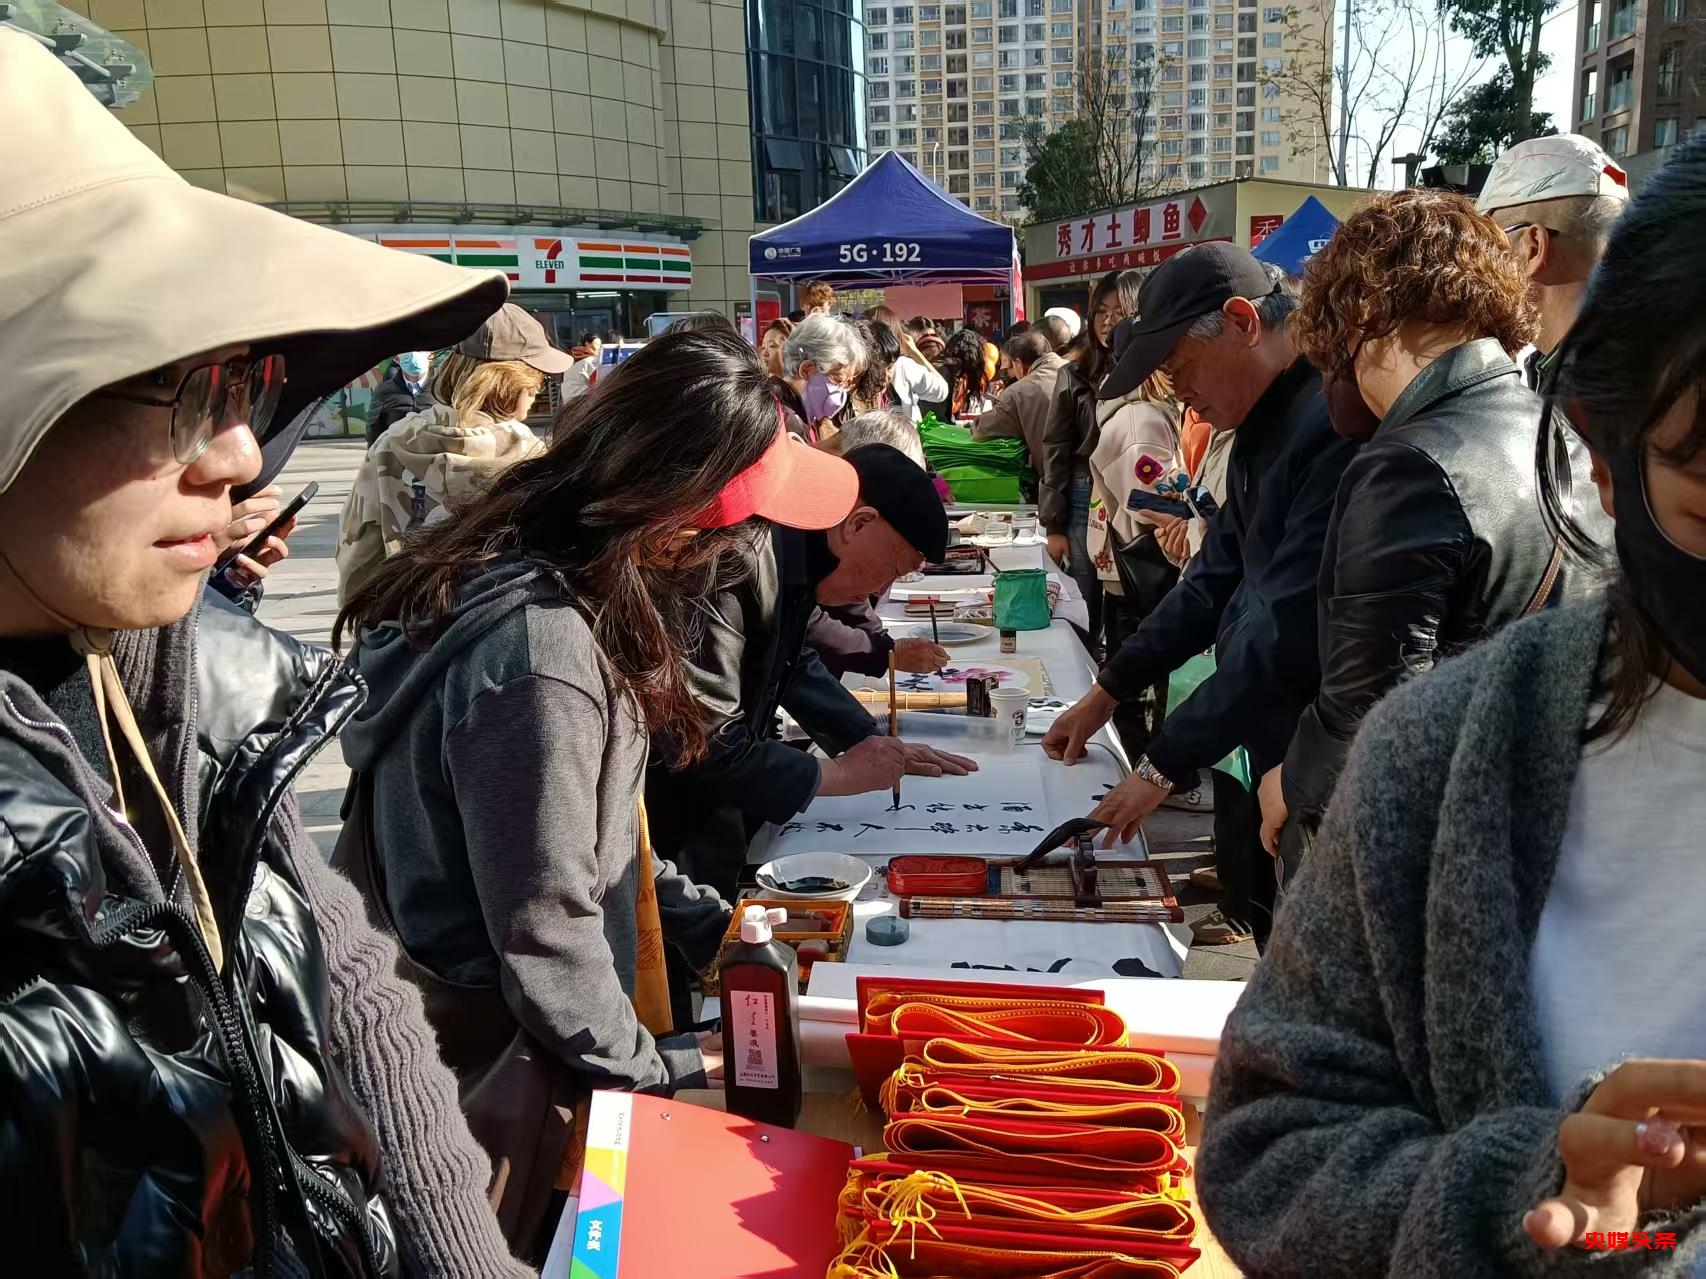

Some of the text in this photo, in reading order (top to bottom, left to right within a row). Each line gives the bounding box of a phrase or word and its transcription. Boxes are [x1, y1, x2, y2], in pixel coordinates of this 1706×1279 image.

[1058, 203, 1181, 256] 秀才土鲫鱼
[534, 239, 562, 283] 7
